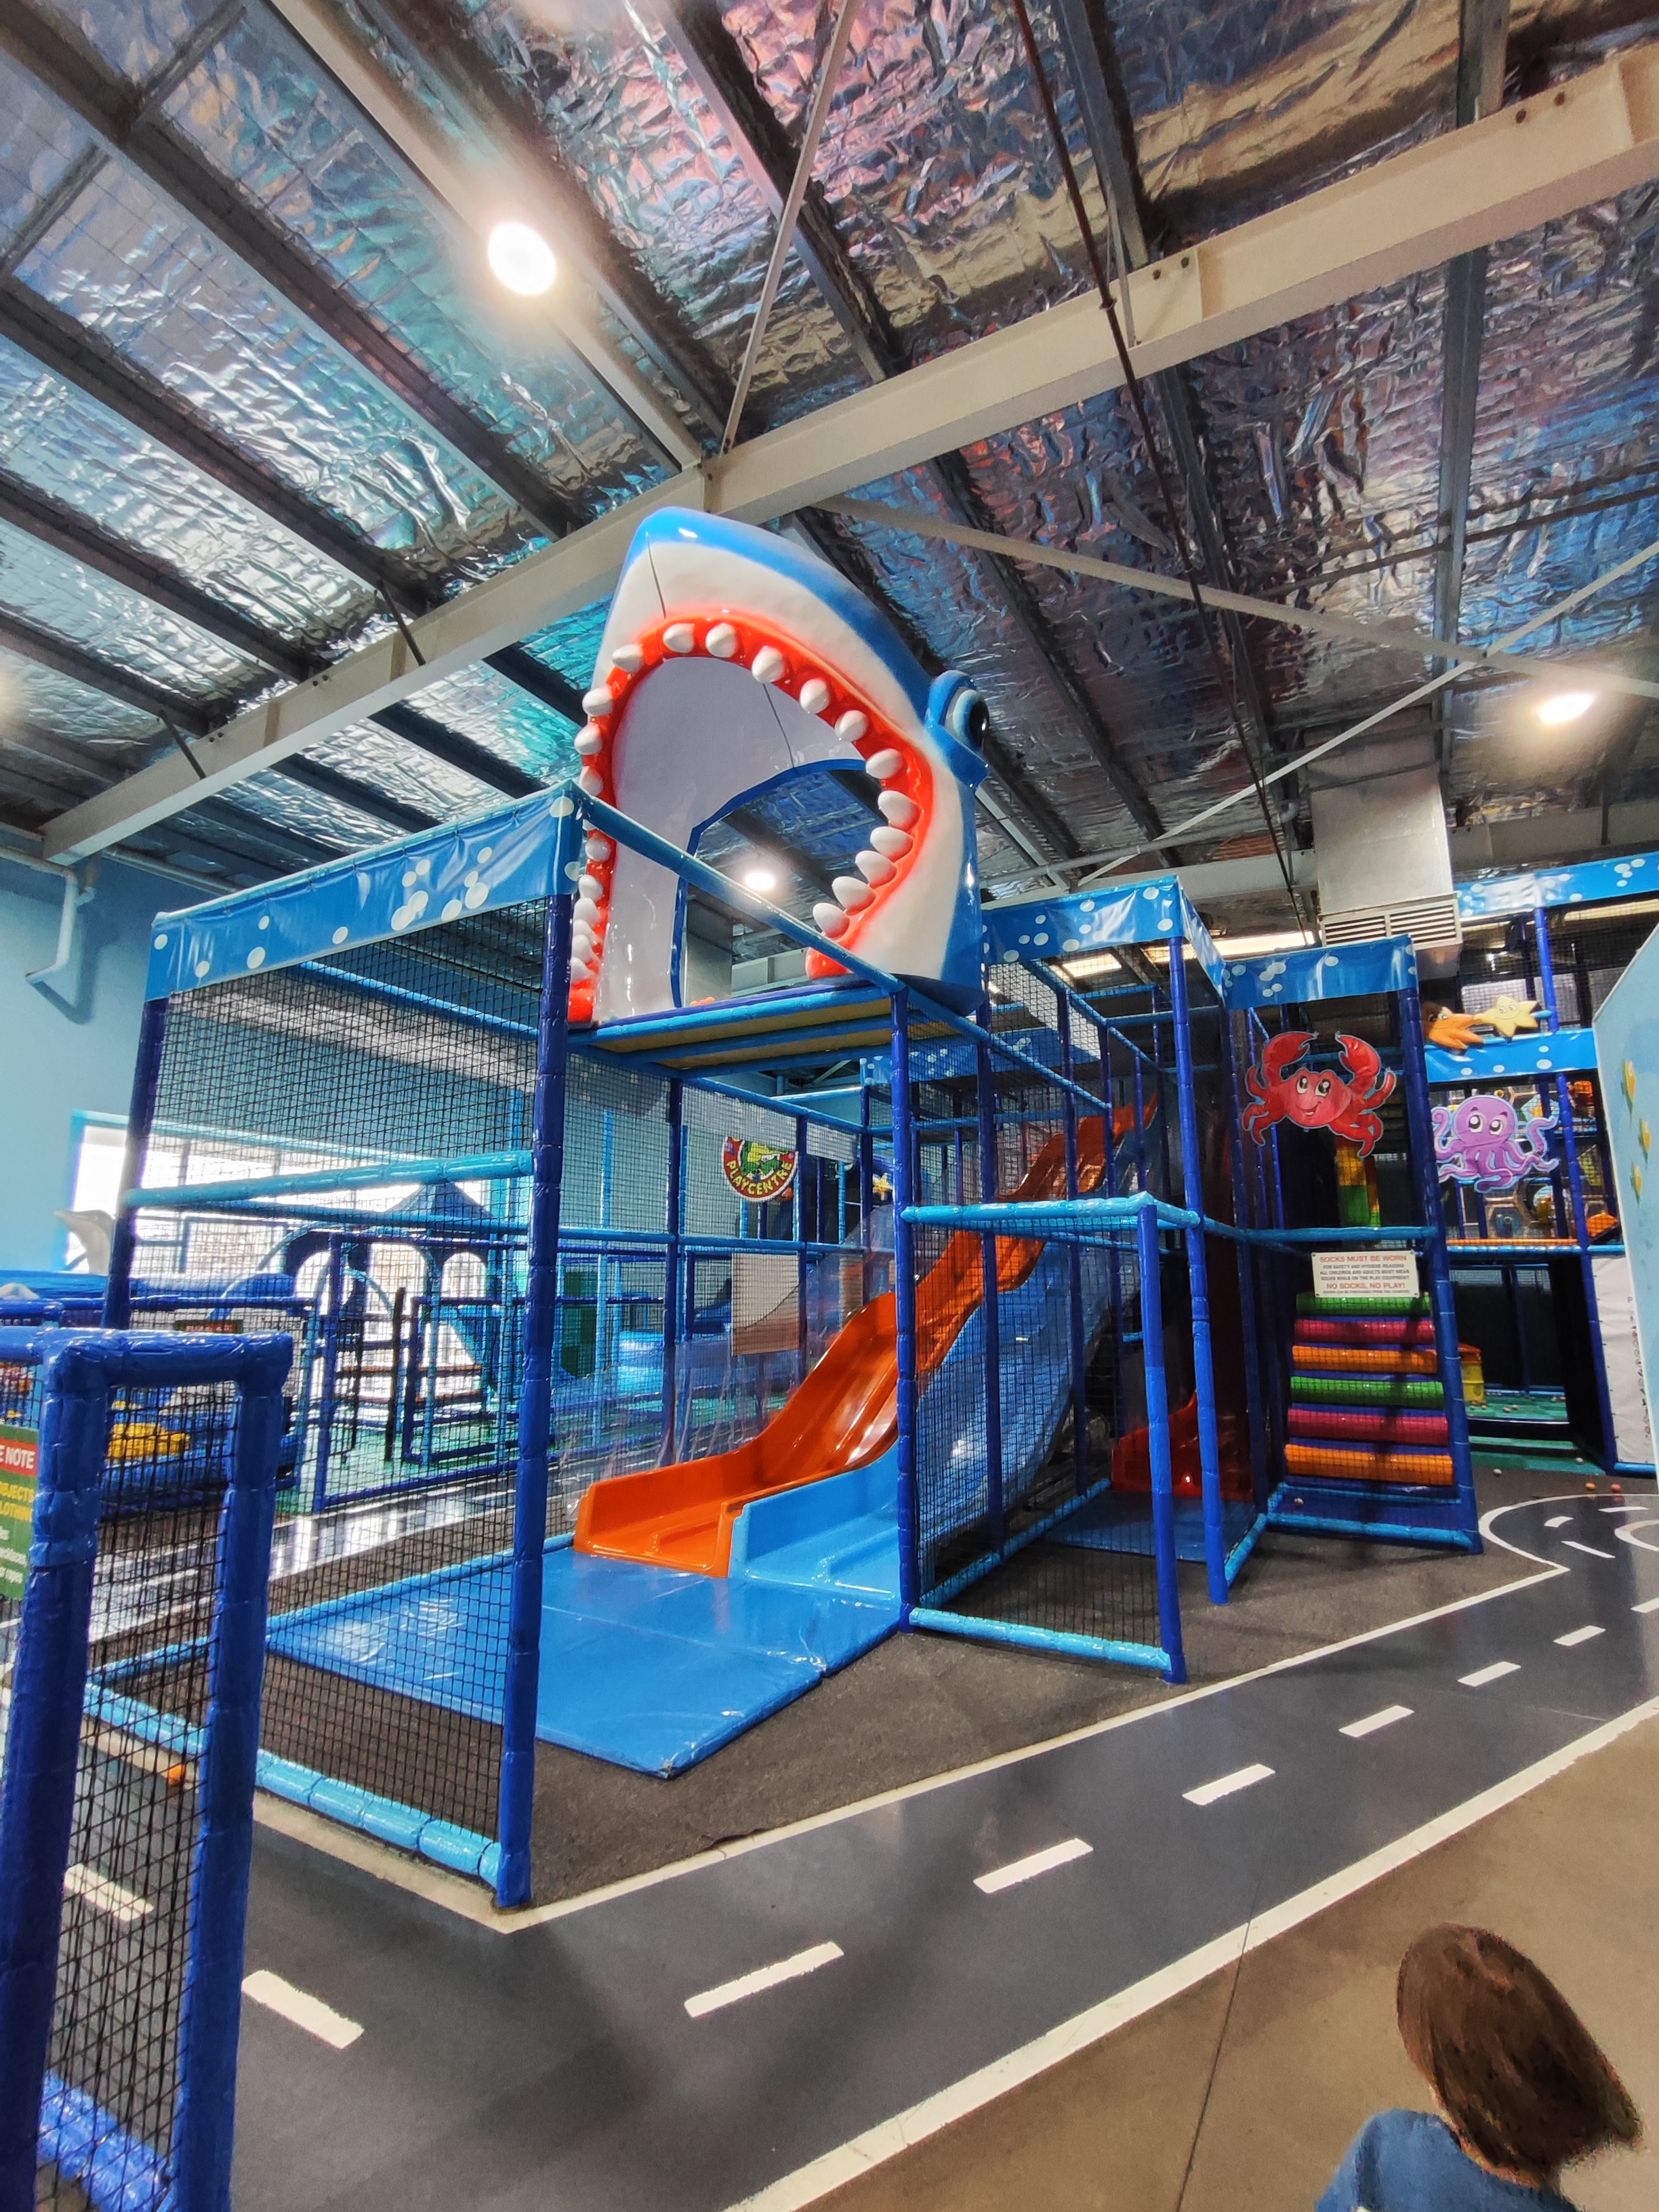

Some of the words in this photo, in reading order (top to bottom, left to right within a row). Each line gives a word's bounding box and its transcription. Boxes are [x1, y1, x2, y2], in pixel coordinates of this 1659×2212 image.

[726, 1160, 792, 1195] PLAYCENTRE
[5, 1446, 36, 1469] NOTE
[0, 1481, 35, 1503] BJECTS
